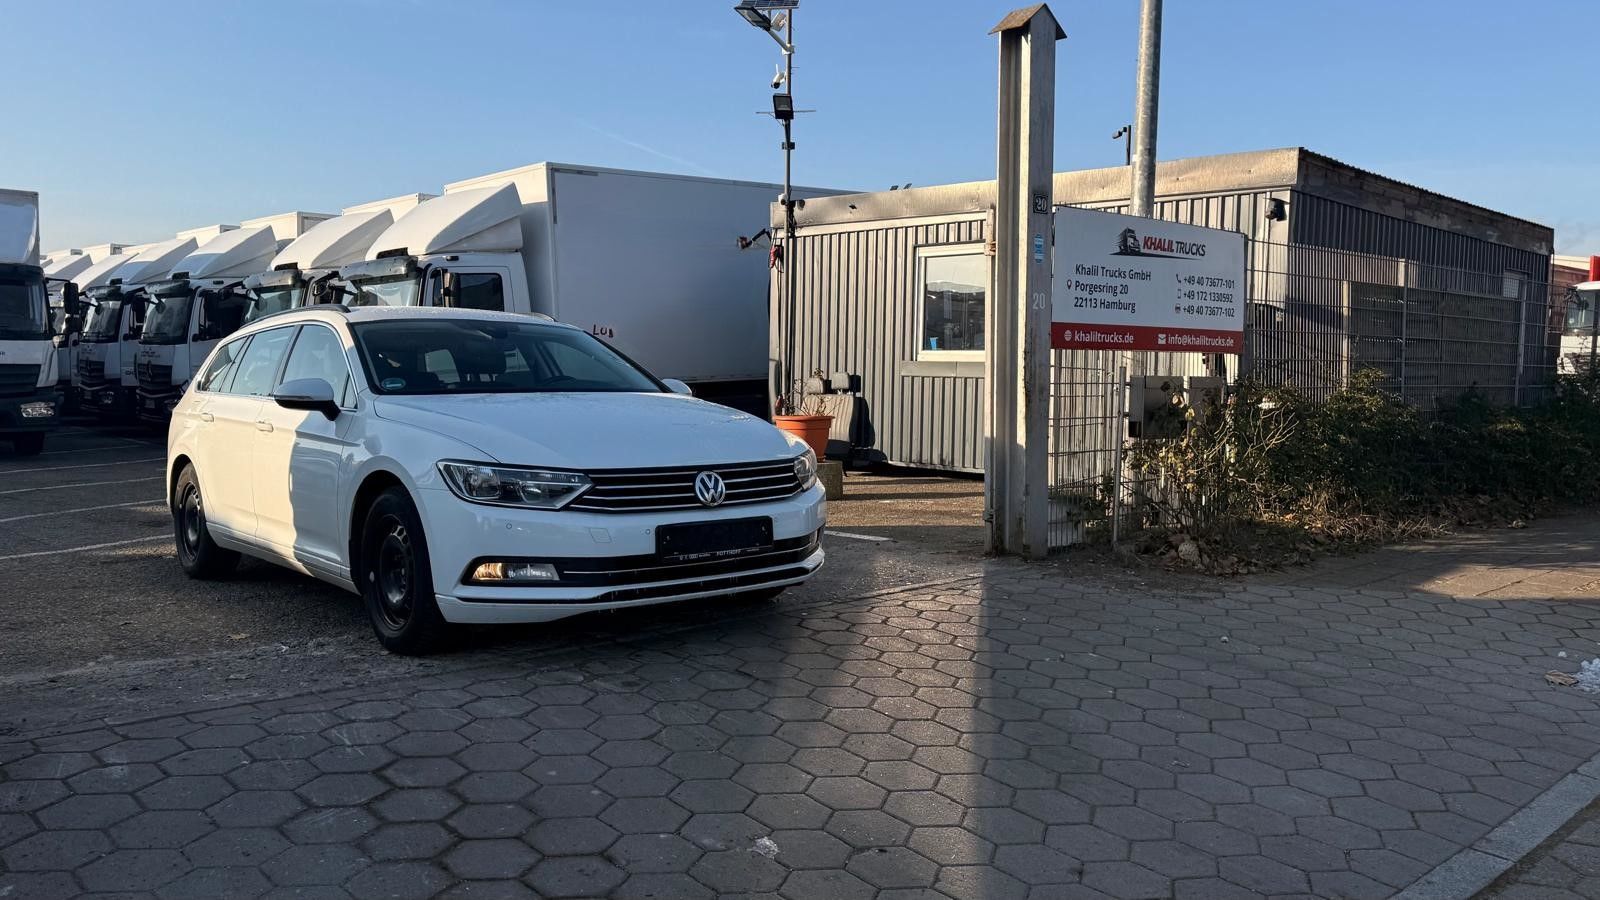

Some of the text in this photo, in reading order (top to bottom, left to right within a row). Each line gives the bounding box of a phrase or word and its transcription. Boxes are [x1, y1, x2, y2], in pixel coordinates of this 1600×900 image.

[1036, 196, 1047, 211] 20
[1143, 236, 1206, 257] KHALIL TRUCKS
[1075, 264, 1151, 281] Khalil Trucks GmbH
[1075, 280, 1129, 297] Porgesring 20
[1183, 275, 1235, 289] +49 40 73677-101
[1033, 292, 1046, 309] 20
[1183, 290, 1233, 303] +49 172 1330592
[1074, 296, 1136, 314] 22113 Hamburg
[1182, 305, 1235, 317] +49 40 73677-102
[1074, 330, 1134, 343] khaliltrucks.de
[1168, 334, 1234, 347] info@khaliltrucks.de
[696, 471, 725, 506] VW
